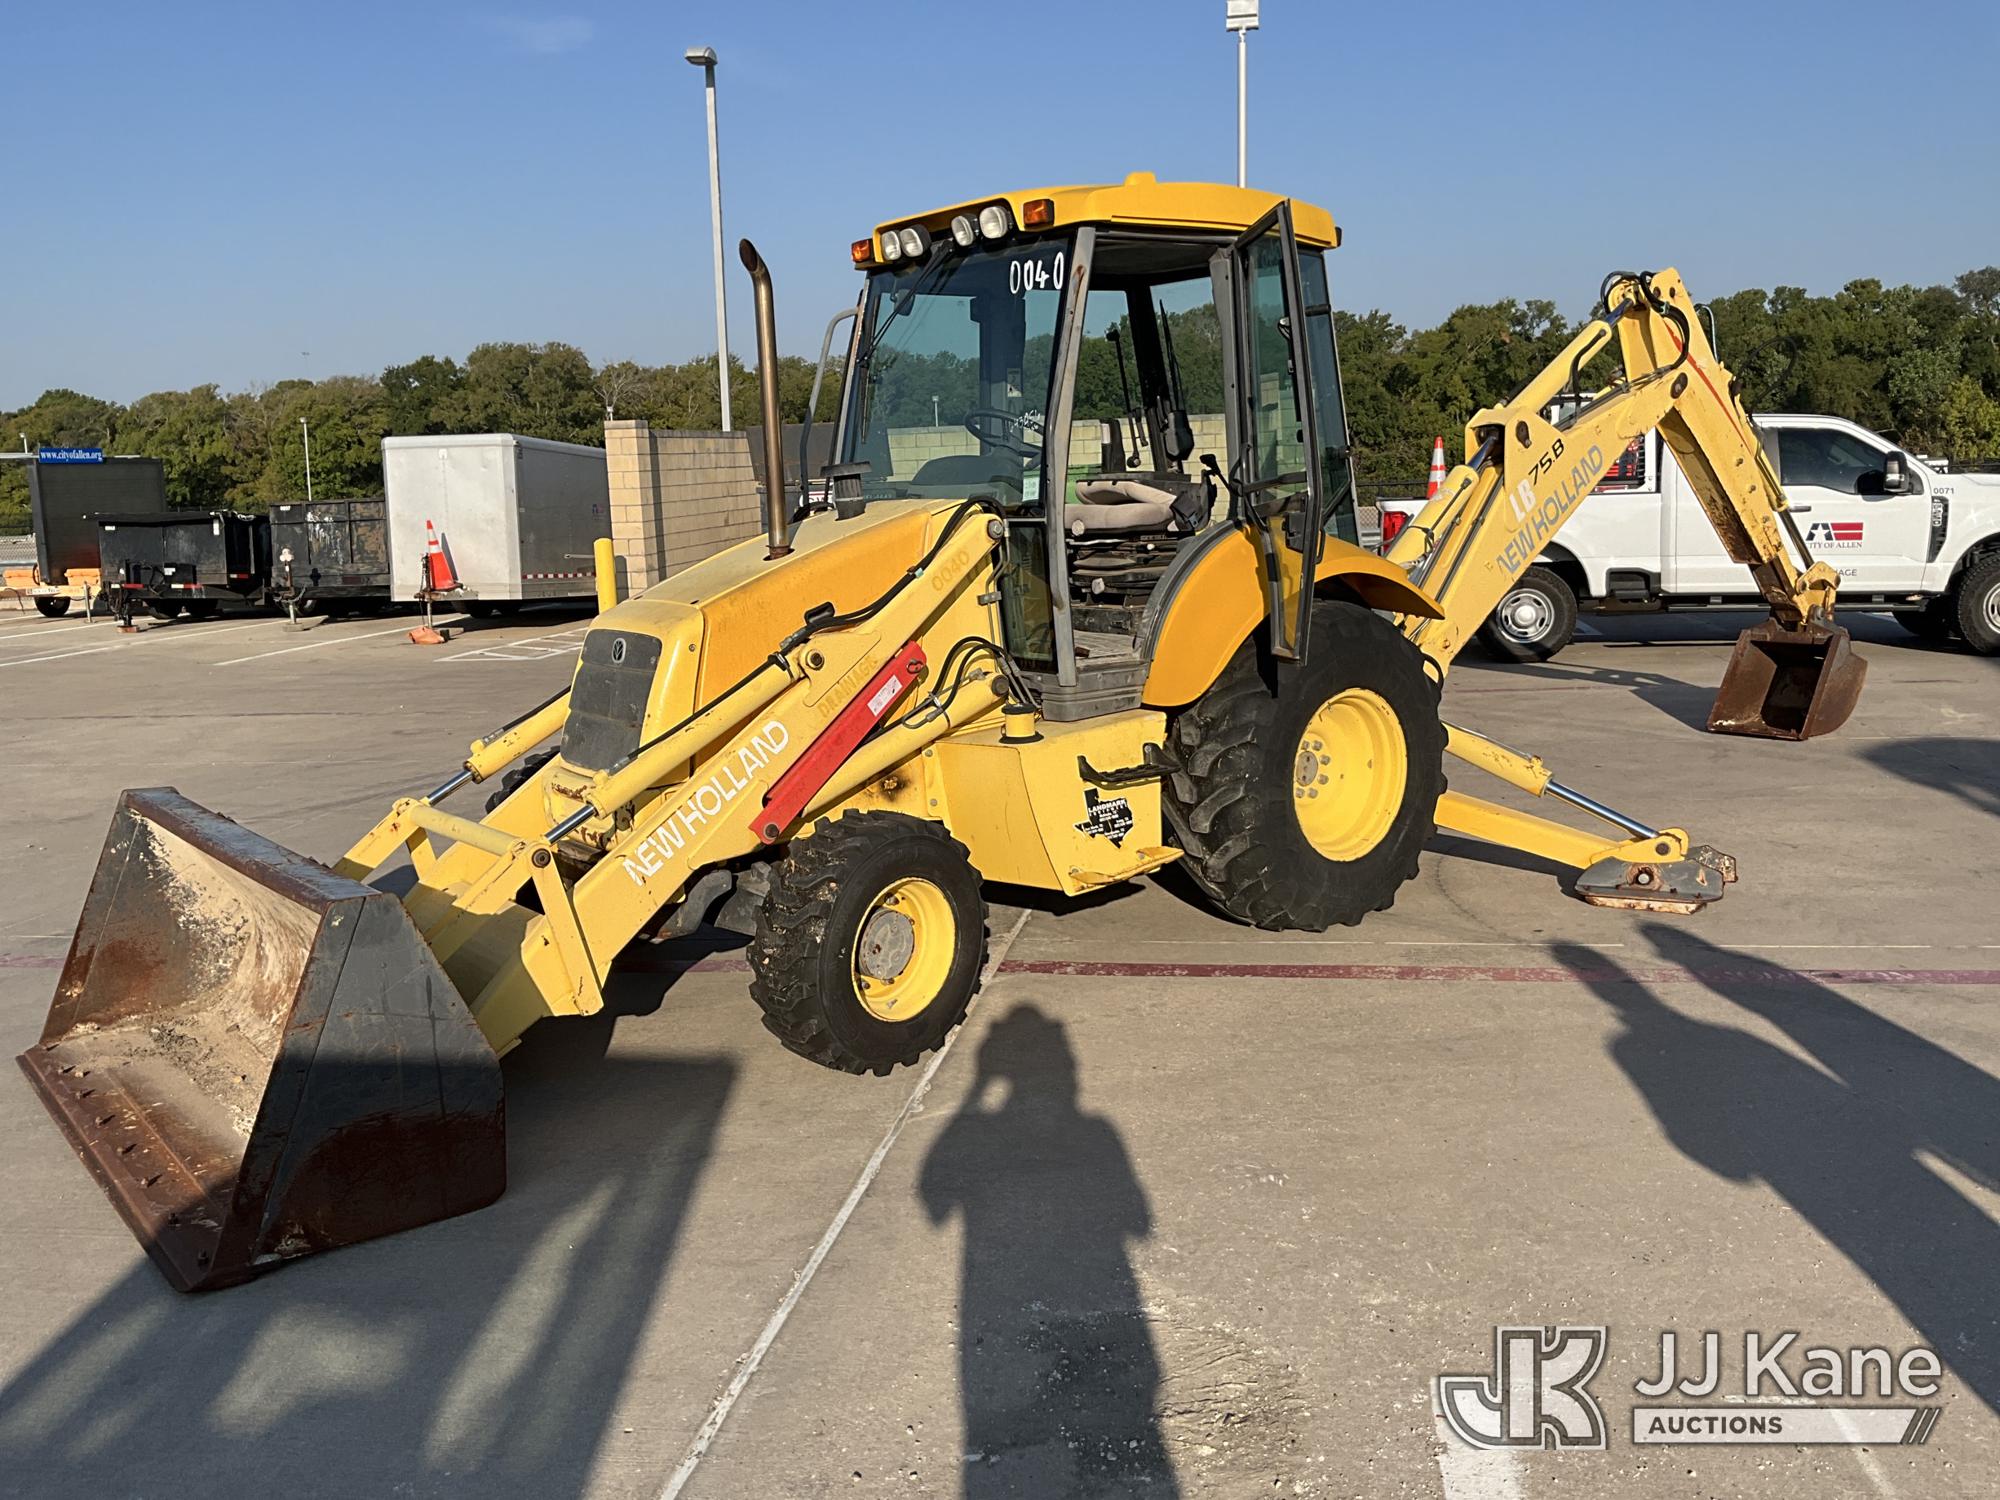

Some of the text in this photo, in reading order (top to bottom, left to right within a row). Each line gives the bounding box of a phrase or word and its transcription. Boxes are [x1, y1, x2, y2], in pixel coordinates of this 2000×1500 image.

[1010, 251, 1065, 294] 0040
[40, 449, 103, 462] www.cityofallen.org
[1509, 438, 1565, 523] LB 75.B
[1933, 487, 1955, 495] 0071
[1496, 445, 1603, 576] NEW HOLLAND
[1824, 541, 1835, 549] OF
[1835, 541, 1862, 549] ALLEN
[623, 720, 789, 887] NEW HOLLAND
[1088, 799, 1126, 813] LANDMARK
